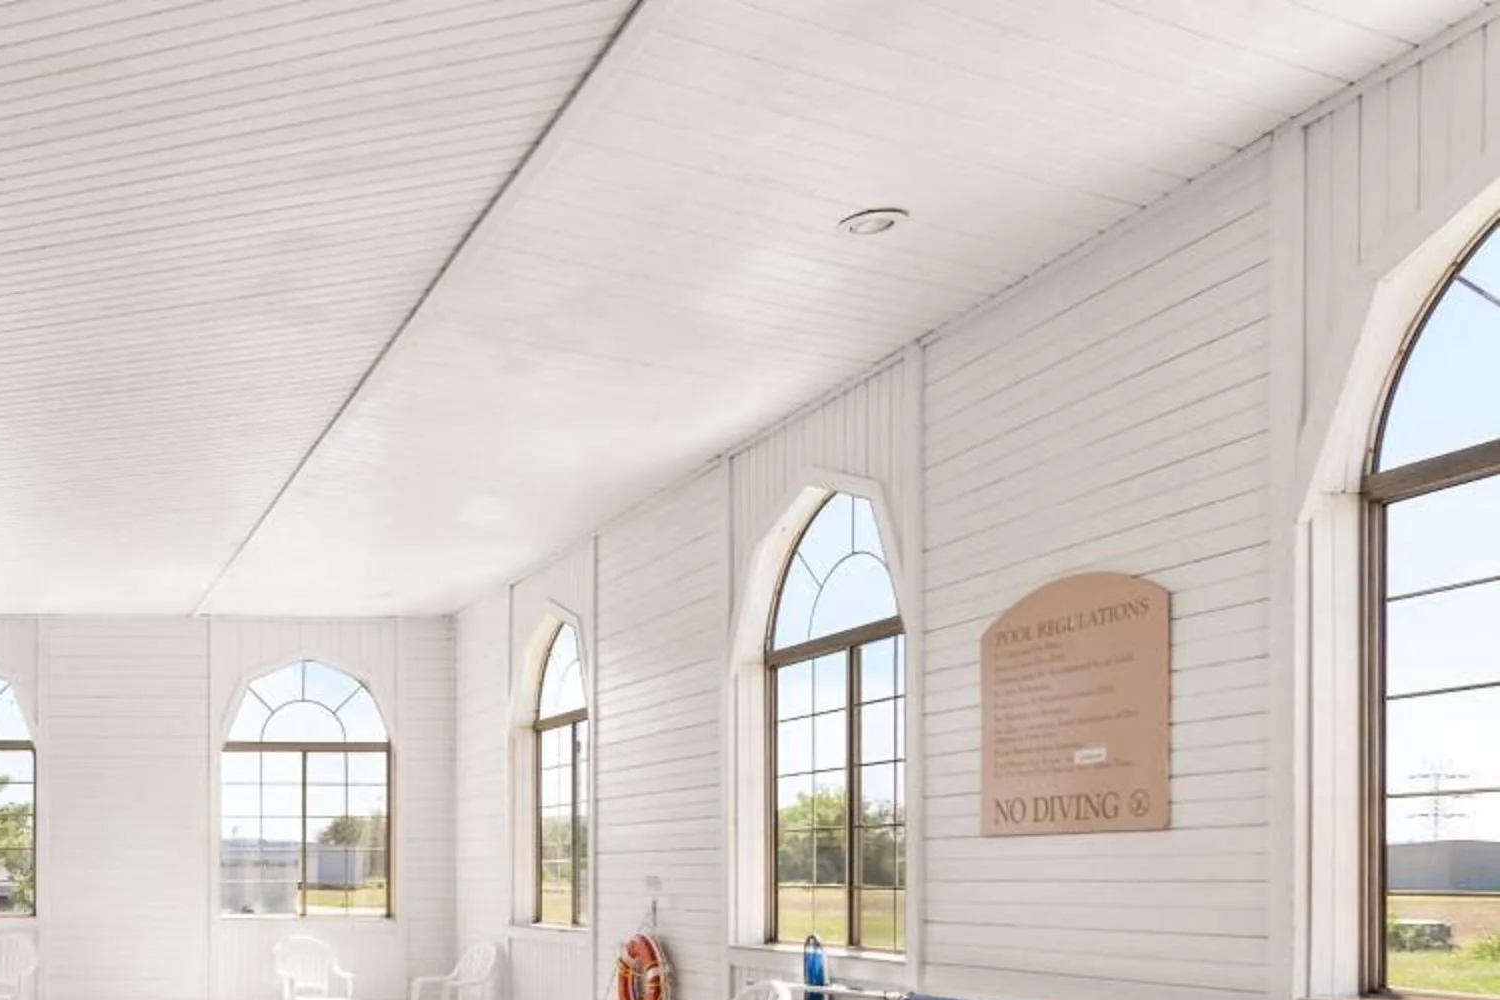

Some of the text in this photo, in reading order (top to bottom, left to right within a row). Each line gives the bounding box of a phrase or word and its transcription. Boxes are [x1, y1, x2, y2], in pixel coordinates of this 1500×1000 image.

[995, 596, 1151, 647] POOL REGULATIONS
[994, 790, 1121, 825] NO DIVING
